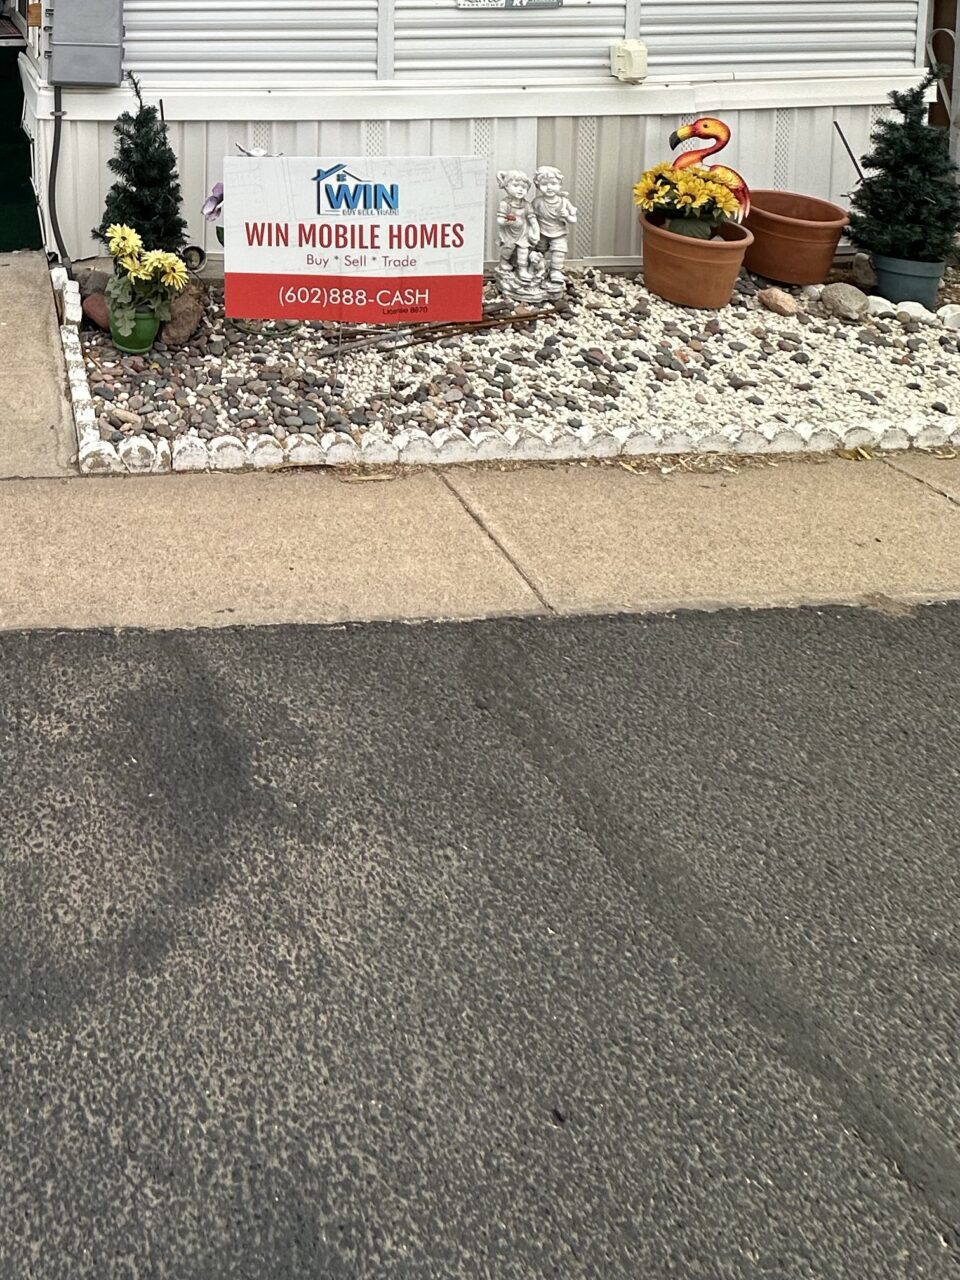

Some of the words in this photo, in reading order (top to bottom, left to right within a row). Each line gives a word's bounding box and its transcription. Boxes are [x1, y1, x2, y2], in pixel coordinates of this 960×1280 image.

[324, 183, 400, 209] WIN
[245, 222, 289, 247] WIN
[298, 223, 380, 250] MOBILE
[388, 223, 465, 250] HOMES
[306, 253, 330, 267] Buy
[344, 253, 367, 267] Sell
[382, 255, 417, 268] Trade
[278, 286, 430, 308] (602)888-CASH
